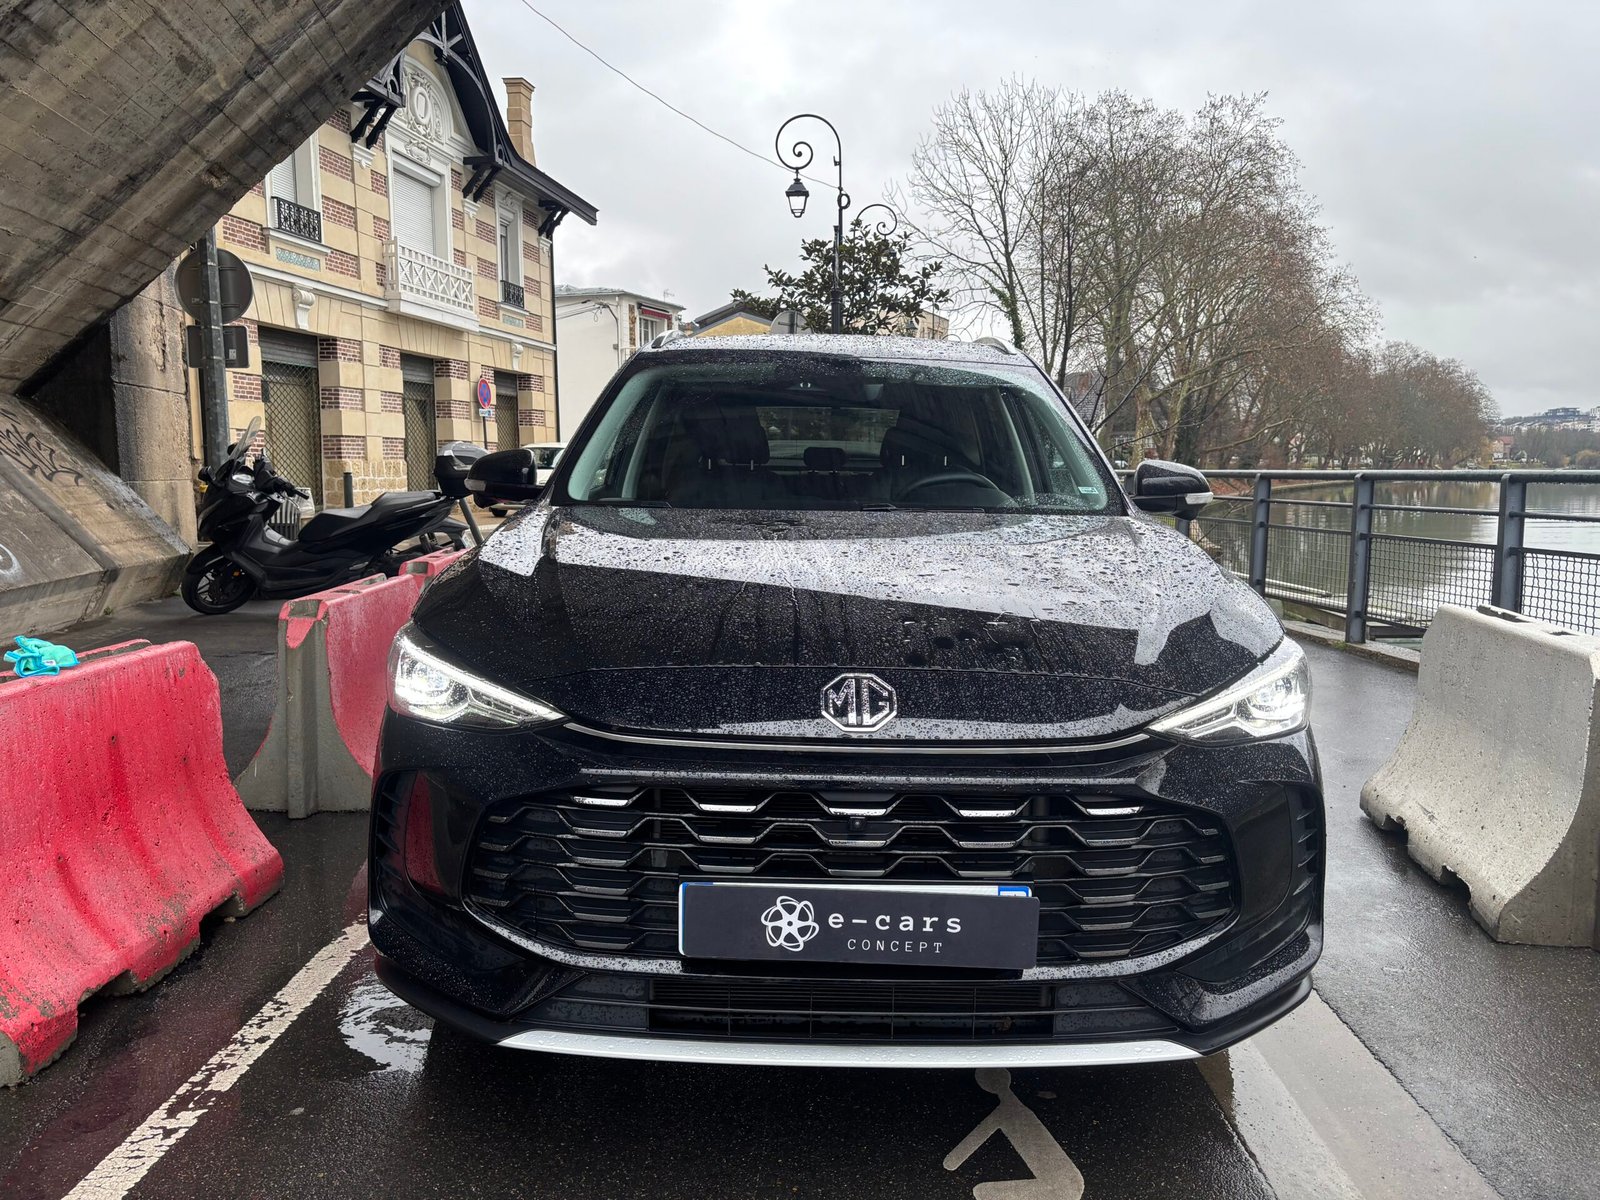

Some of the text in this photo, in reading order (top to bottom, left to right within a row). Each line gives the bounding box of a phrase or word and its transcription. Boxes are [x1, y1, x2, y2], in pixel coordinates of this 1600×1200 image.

[827, 678, 890, 726] MG
[827, 912, 963, 934] e-cars
[847, 938, 943, 954] CONCEPT
